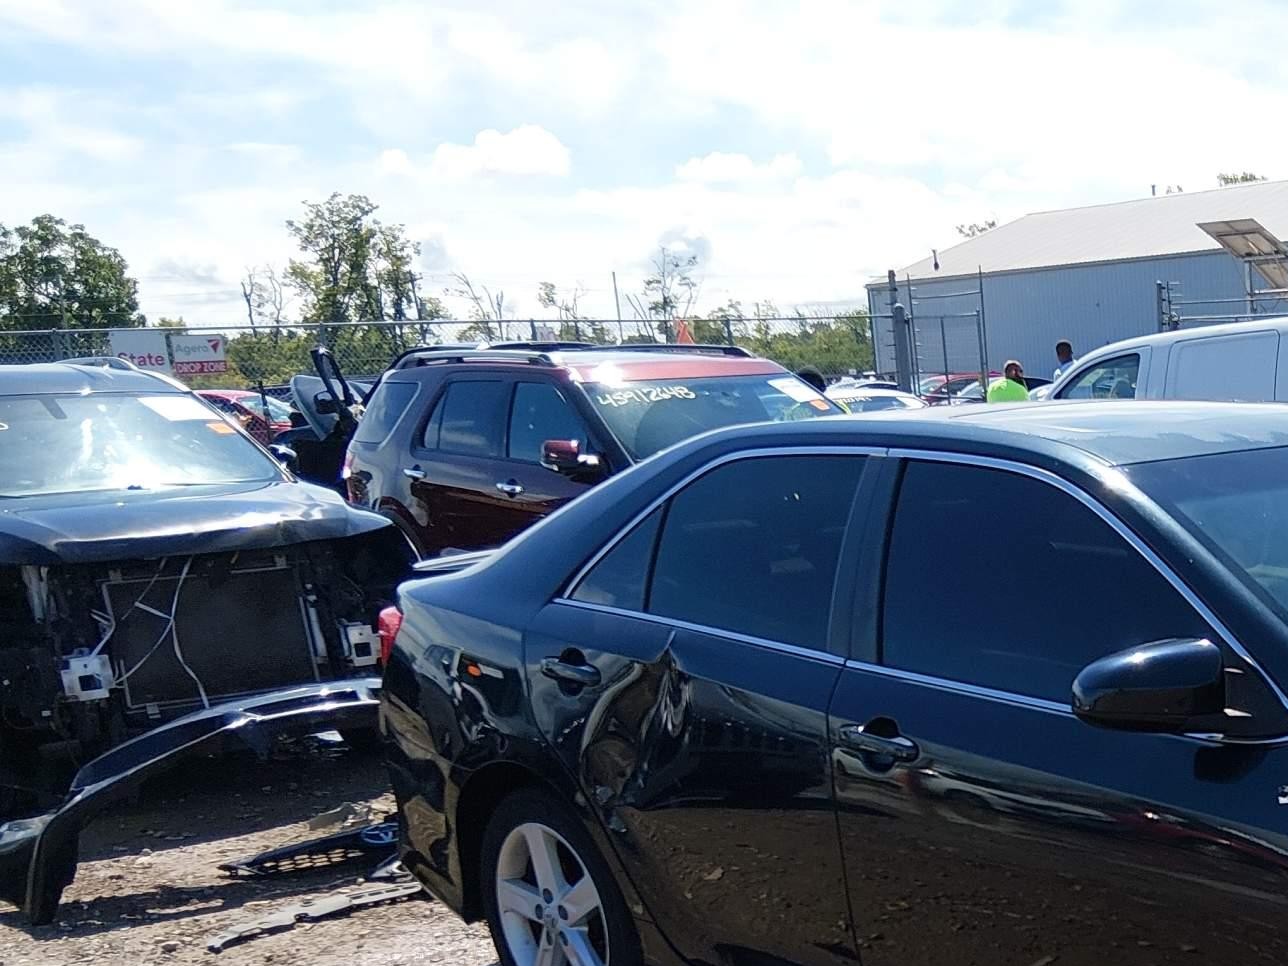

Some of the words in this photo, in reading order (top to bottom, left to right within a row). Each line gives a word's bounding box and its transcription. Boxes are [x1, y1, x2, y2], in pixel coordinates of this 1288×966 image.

[175, 343, 208, 355] Agero
[176, 362, 201, 373] DROP
[203, 361, 226, 372] ZONE
